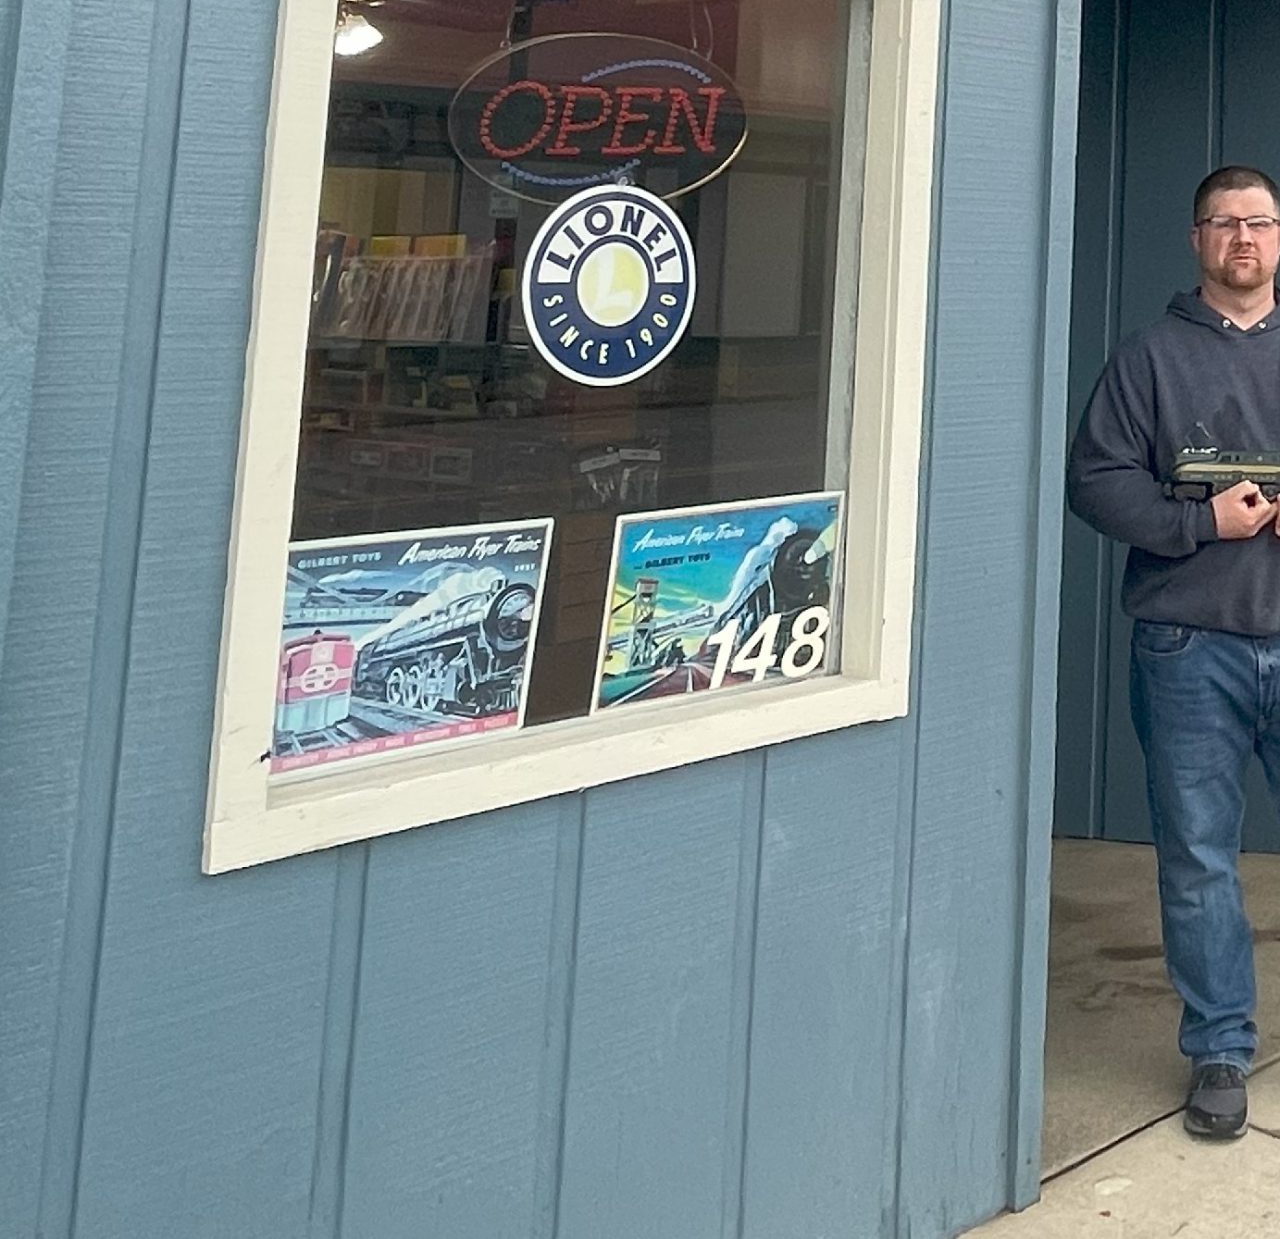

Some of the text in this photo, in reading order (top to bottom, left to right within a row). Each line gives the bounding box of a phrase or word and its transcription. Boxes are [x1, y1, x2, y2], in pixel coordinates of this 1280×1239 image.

[479, 79, 727, 158] OPEN
[546, 205, 678, 272] LIONEL
[543, 293, 678, 365] SINCE 1900
[297, 551, 382, 569] GILBERT TOYS
[398, 533, 542, 565] American Flyer Trains
[632, 528, 686, 553] American
[645, 555, 684, 569] GILBERT
[687, 552, 712, 564] TOYS
[707, 606, 830, 690] 148
